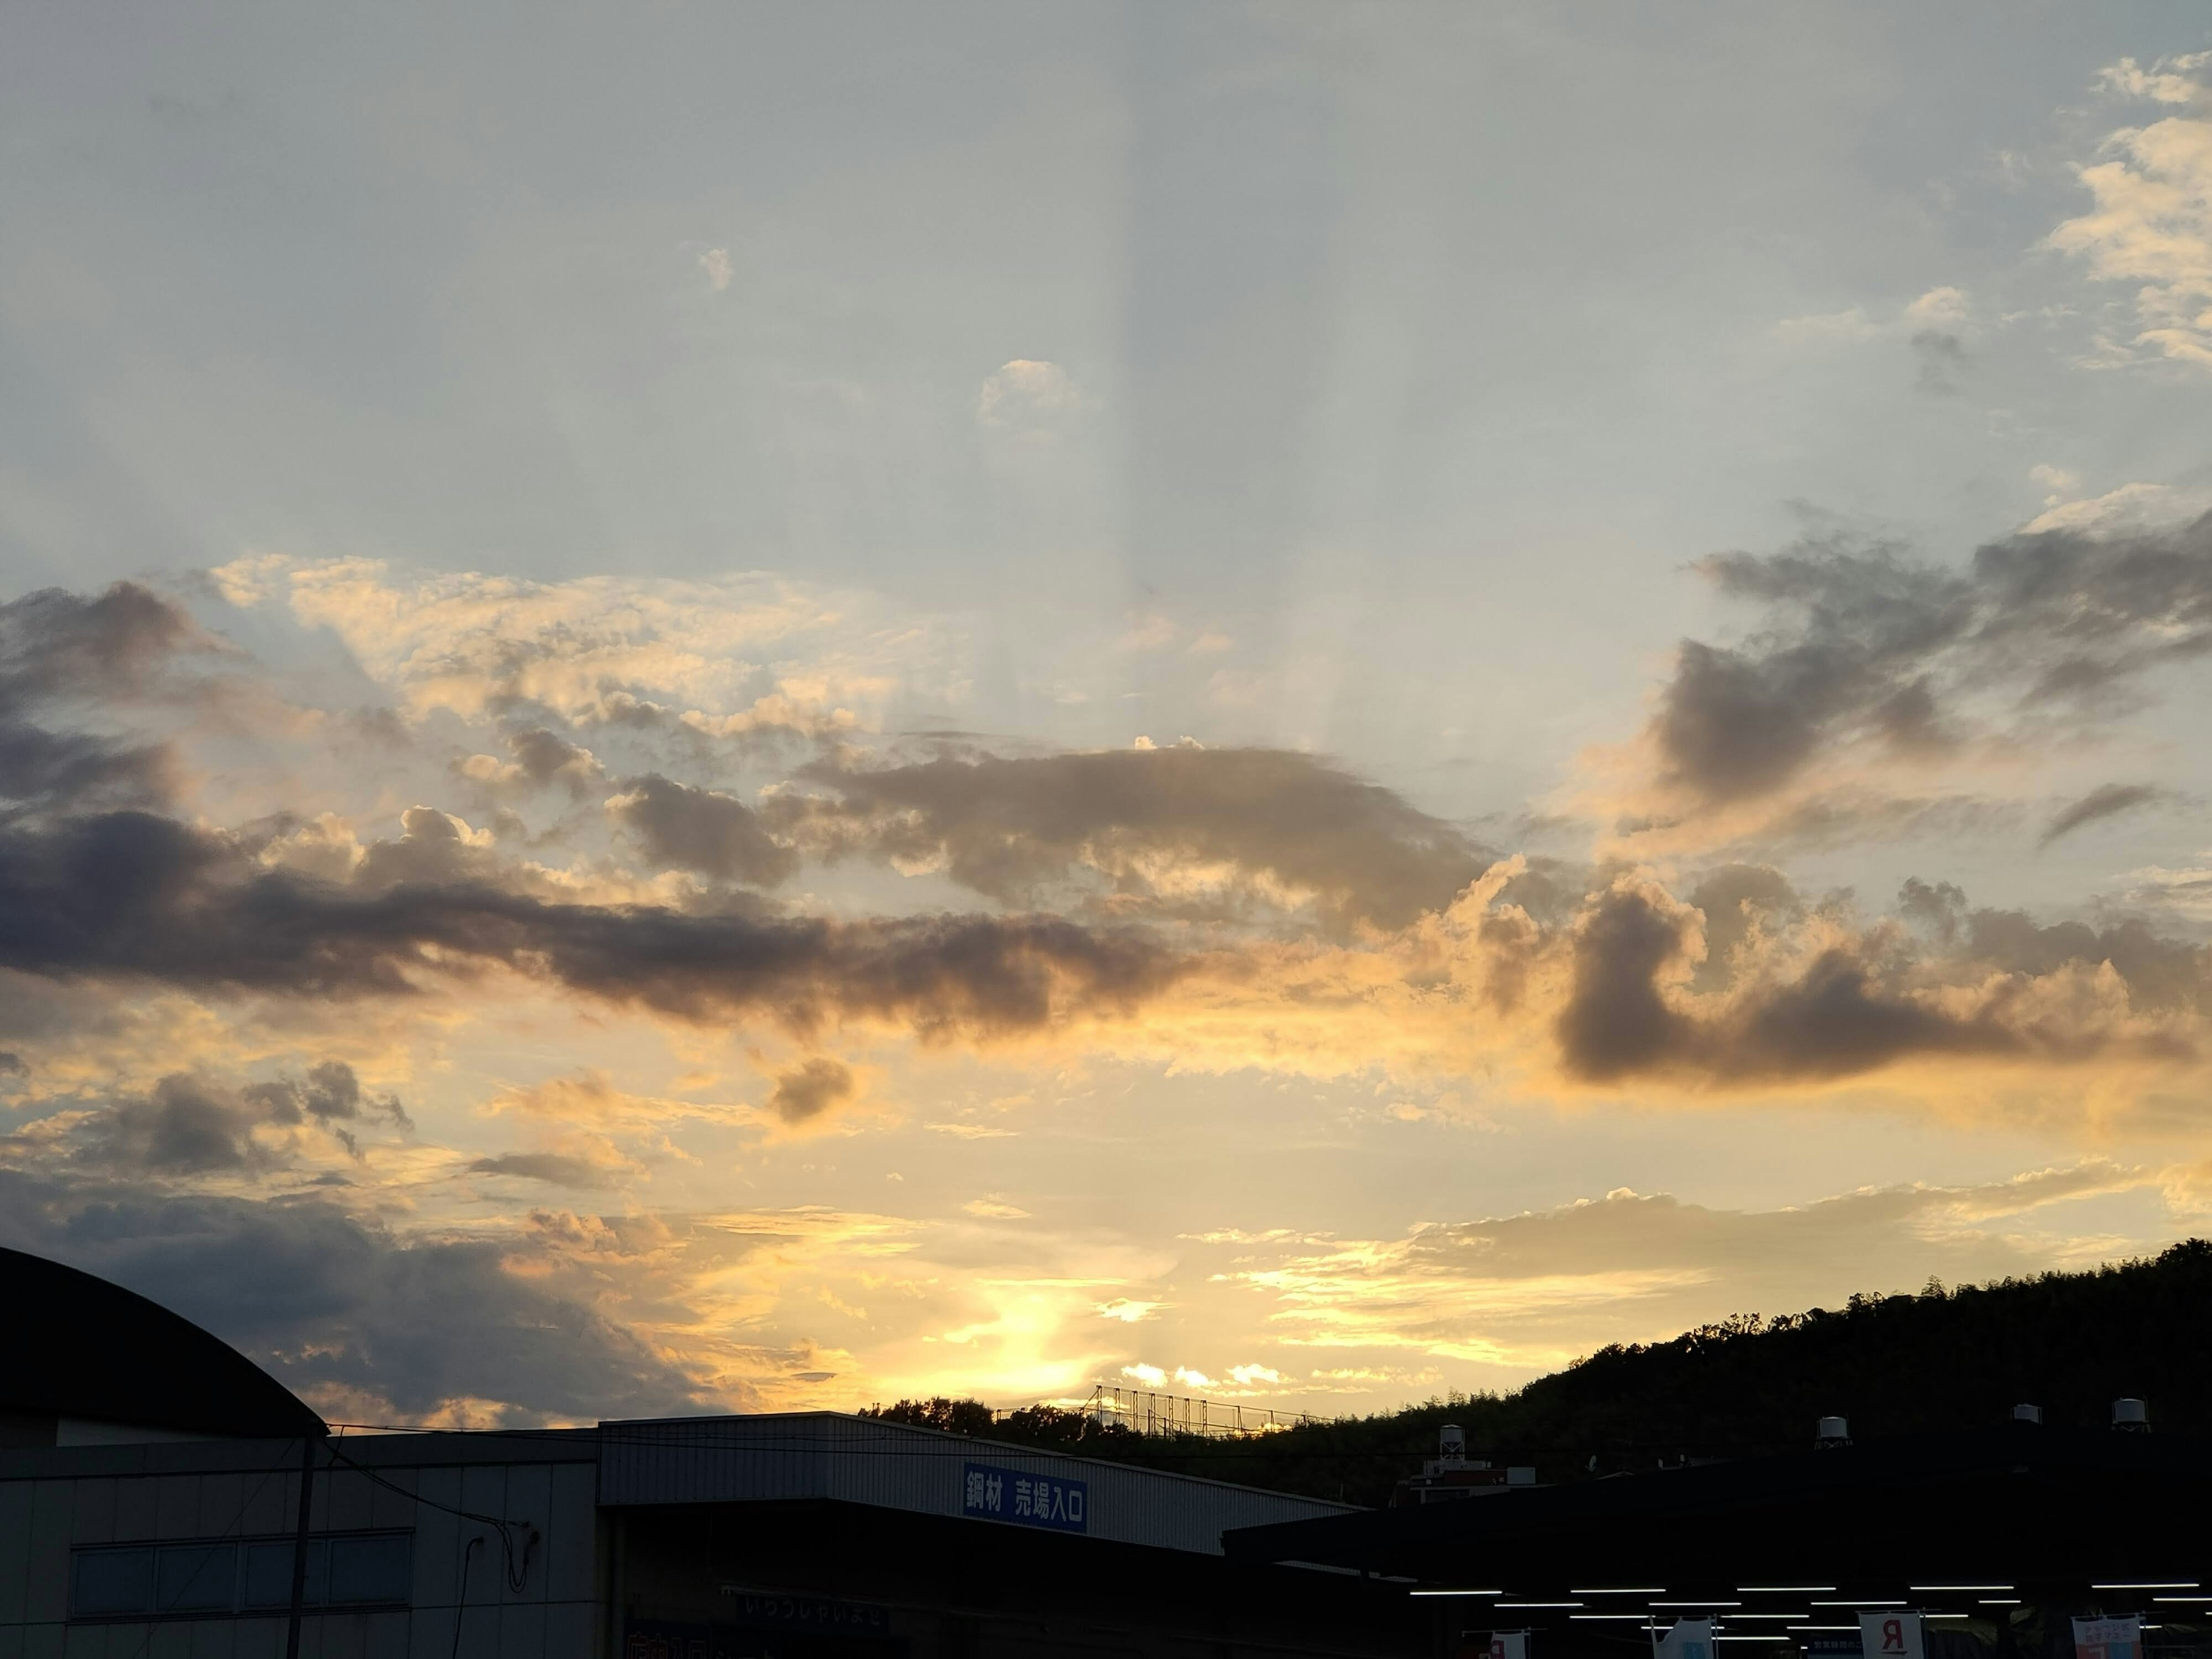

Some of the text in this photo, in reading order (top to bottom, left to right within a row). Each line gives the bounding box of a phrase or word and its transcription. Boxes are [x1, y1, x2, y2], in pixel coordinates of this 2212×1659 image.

[967, 1471, 1082, 1522] 鋼材 売場入口
